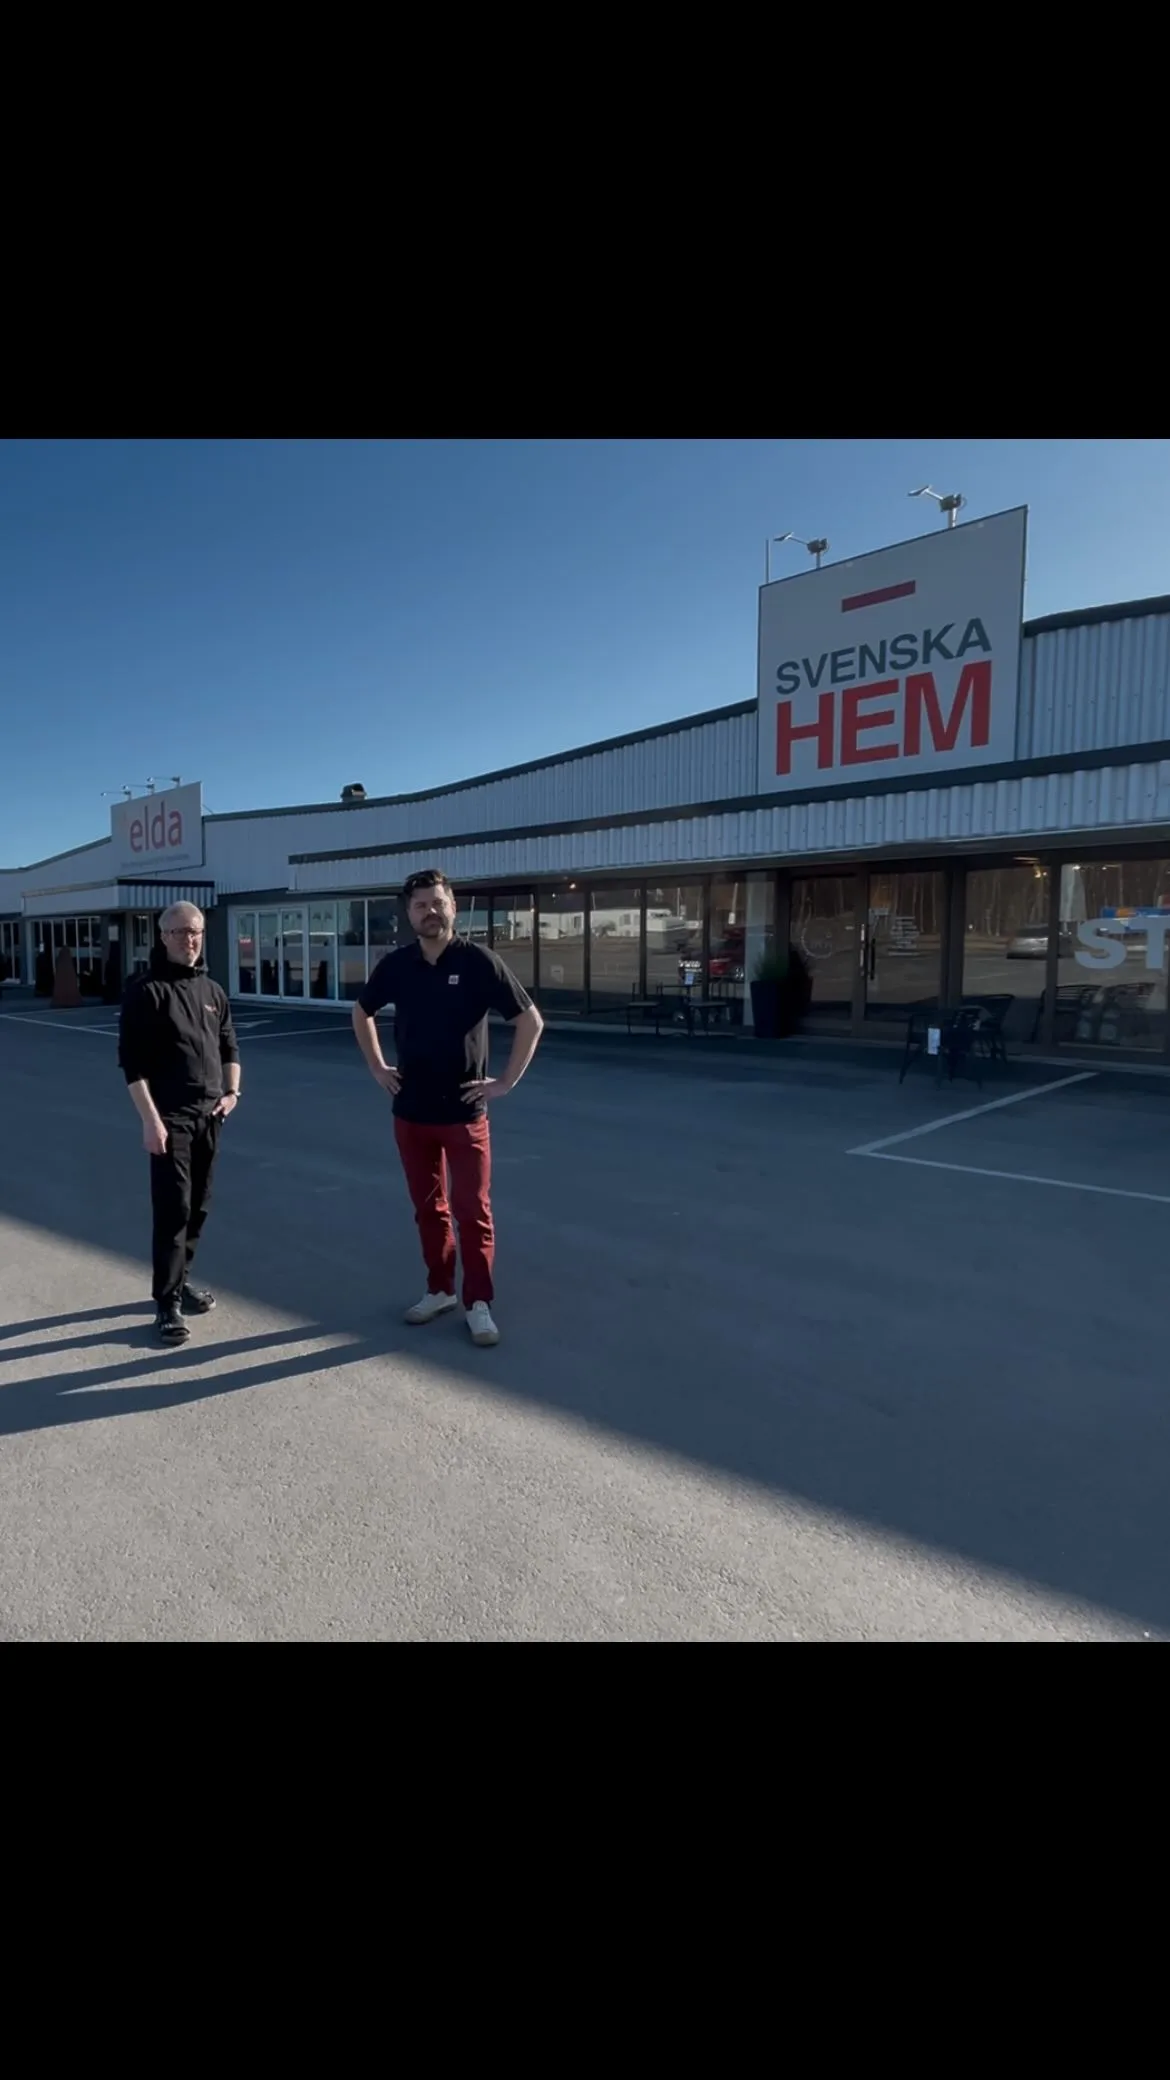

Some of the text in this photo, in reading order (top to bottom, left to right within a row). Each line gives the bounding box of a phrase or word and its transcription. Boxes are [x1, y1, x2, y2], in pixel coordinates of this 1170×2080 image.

[776, 617, 992, 695] SVENSKA
[776, 660, 992, 775] HEM
[129, 800, 183, 853] elda
